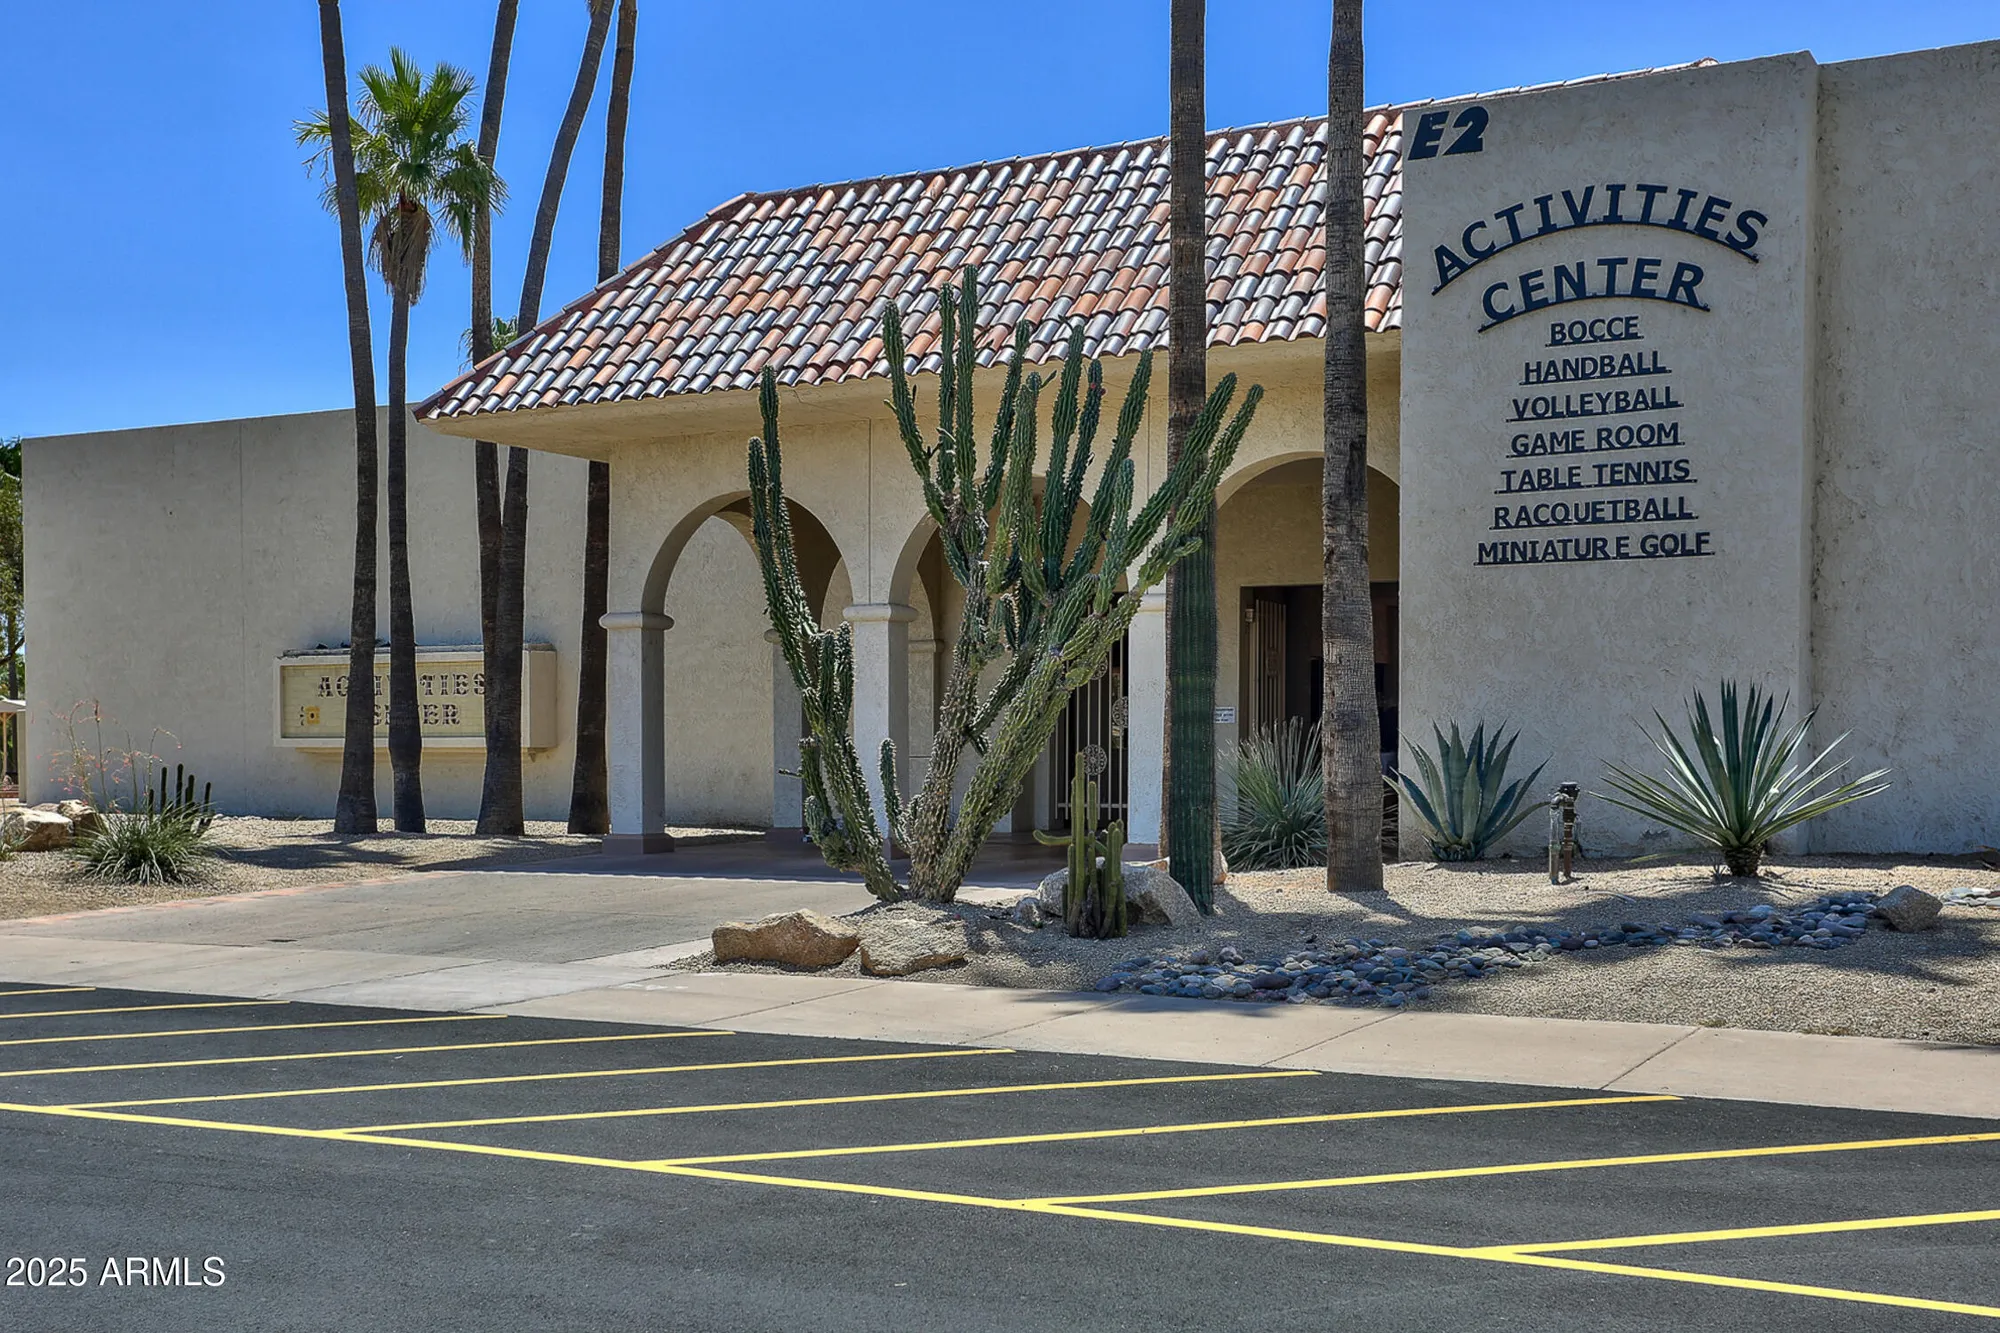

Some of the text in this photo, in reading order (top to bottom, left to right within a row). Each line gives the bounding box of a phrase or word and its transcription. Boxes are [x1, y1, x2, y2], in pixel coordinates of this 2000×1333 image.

[1407, 106, 1490, 161] E2
[1433, 184, 1769, 287] ACTIVITIES
[1482, 257, 1705, 320] CENTER
[1549, 316, 1640, 344] BOCCE
[1523, 351, 1668, 384] HANDBALL
[1511, 386, 1679, 420] VOLLEYBALL
[1511, 422, 1679, 456] GAME ROOM
[1501, 459, 1691, 492] TABLE TENNIS
[1494, 496, 1694, 528] RACQUETBALL
[1477, 532, 1711, 563] MINIATURE GOLF
[318, 673, 486, 697] ACITIES
